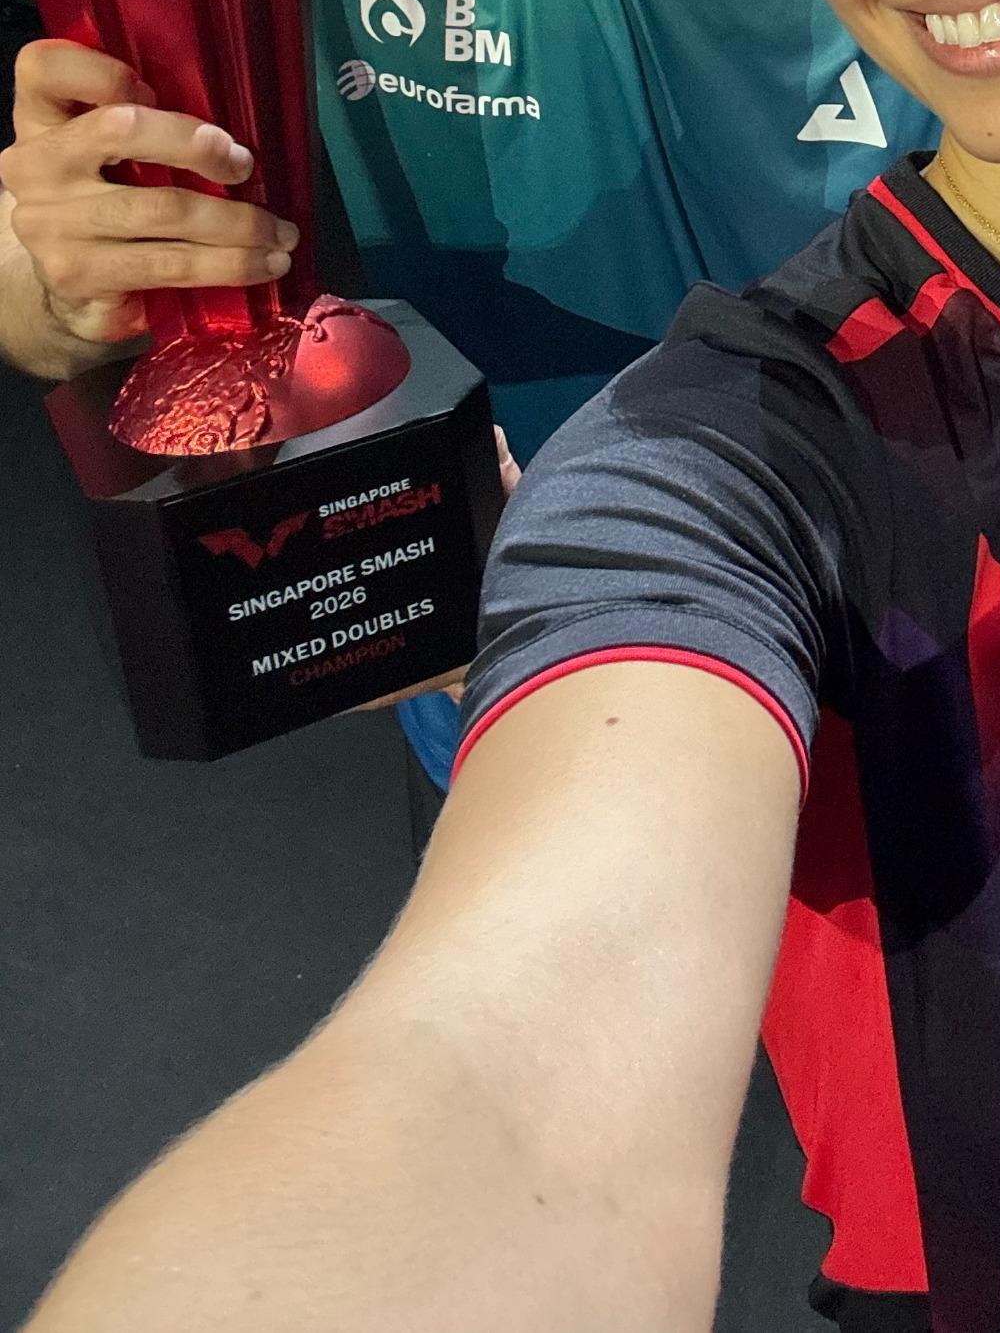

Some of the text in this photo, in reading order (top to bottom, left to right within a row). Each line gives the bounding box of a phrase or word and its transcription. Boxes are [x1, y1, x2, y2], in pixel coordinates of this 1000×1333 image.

[378, 72, 541, 120] eurofarma
[318, 478, 411, 518] SINGAPORE
[228, 537, 436, 622] SINGAPORE SMASH
[309, 586, 368, 620] 2026
[251, 598, 436, 677] MIXED DOUBLES
